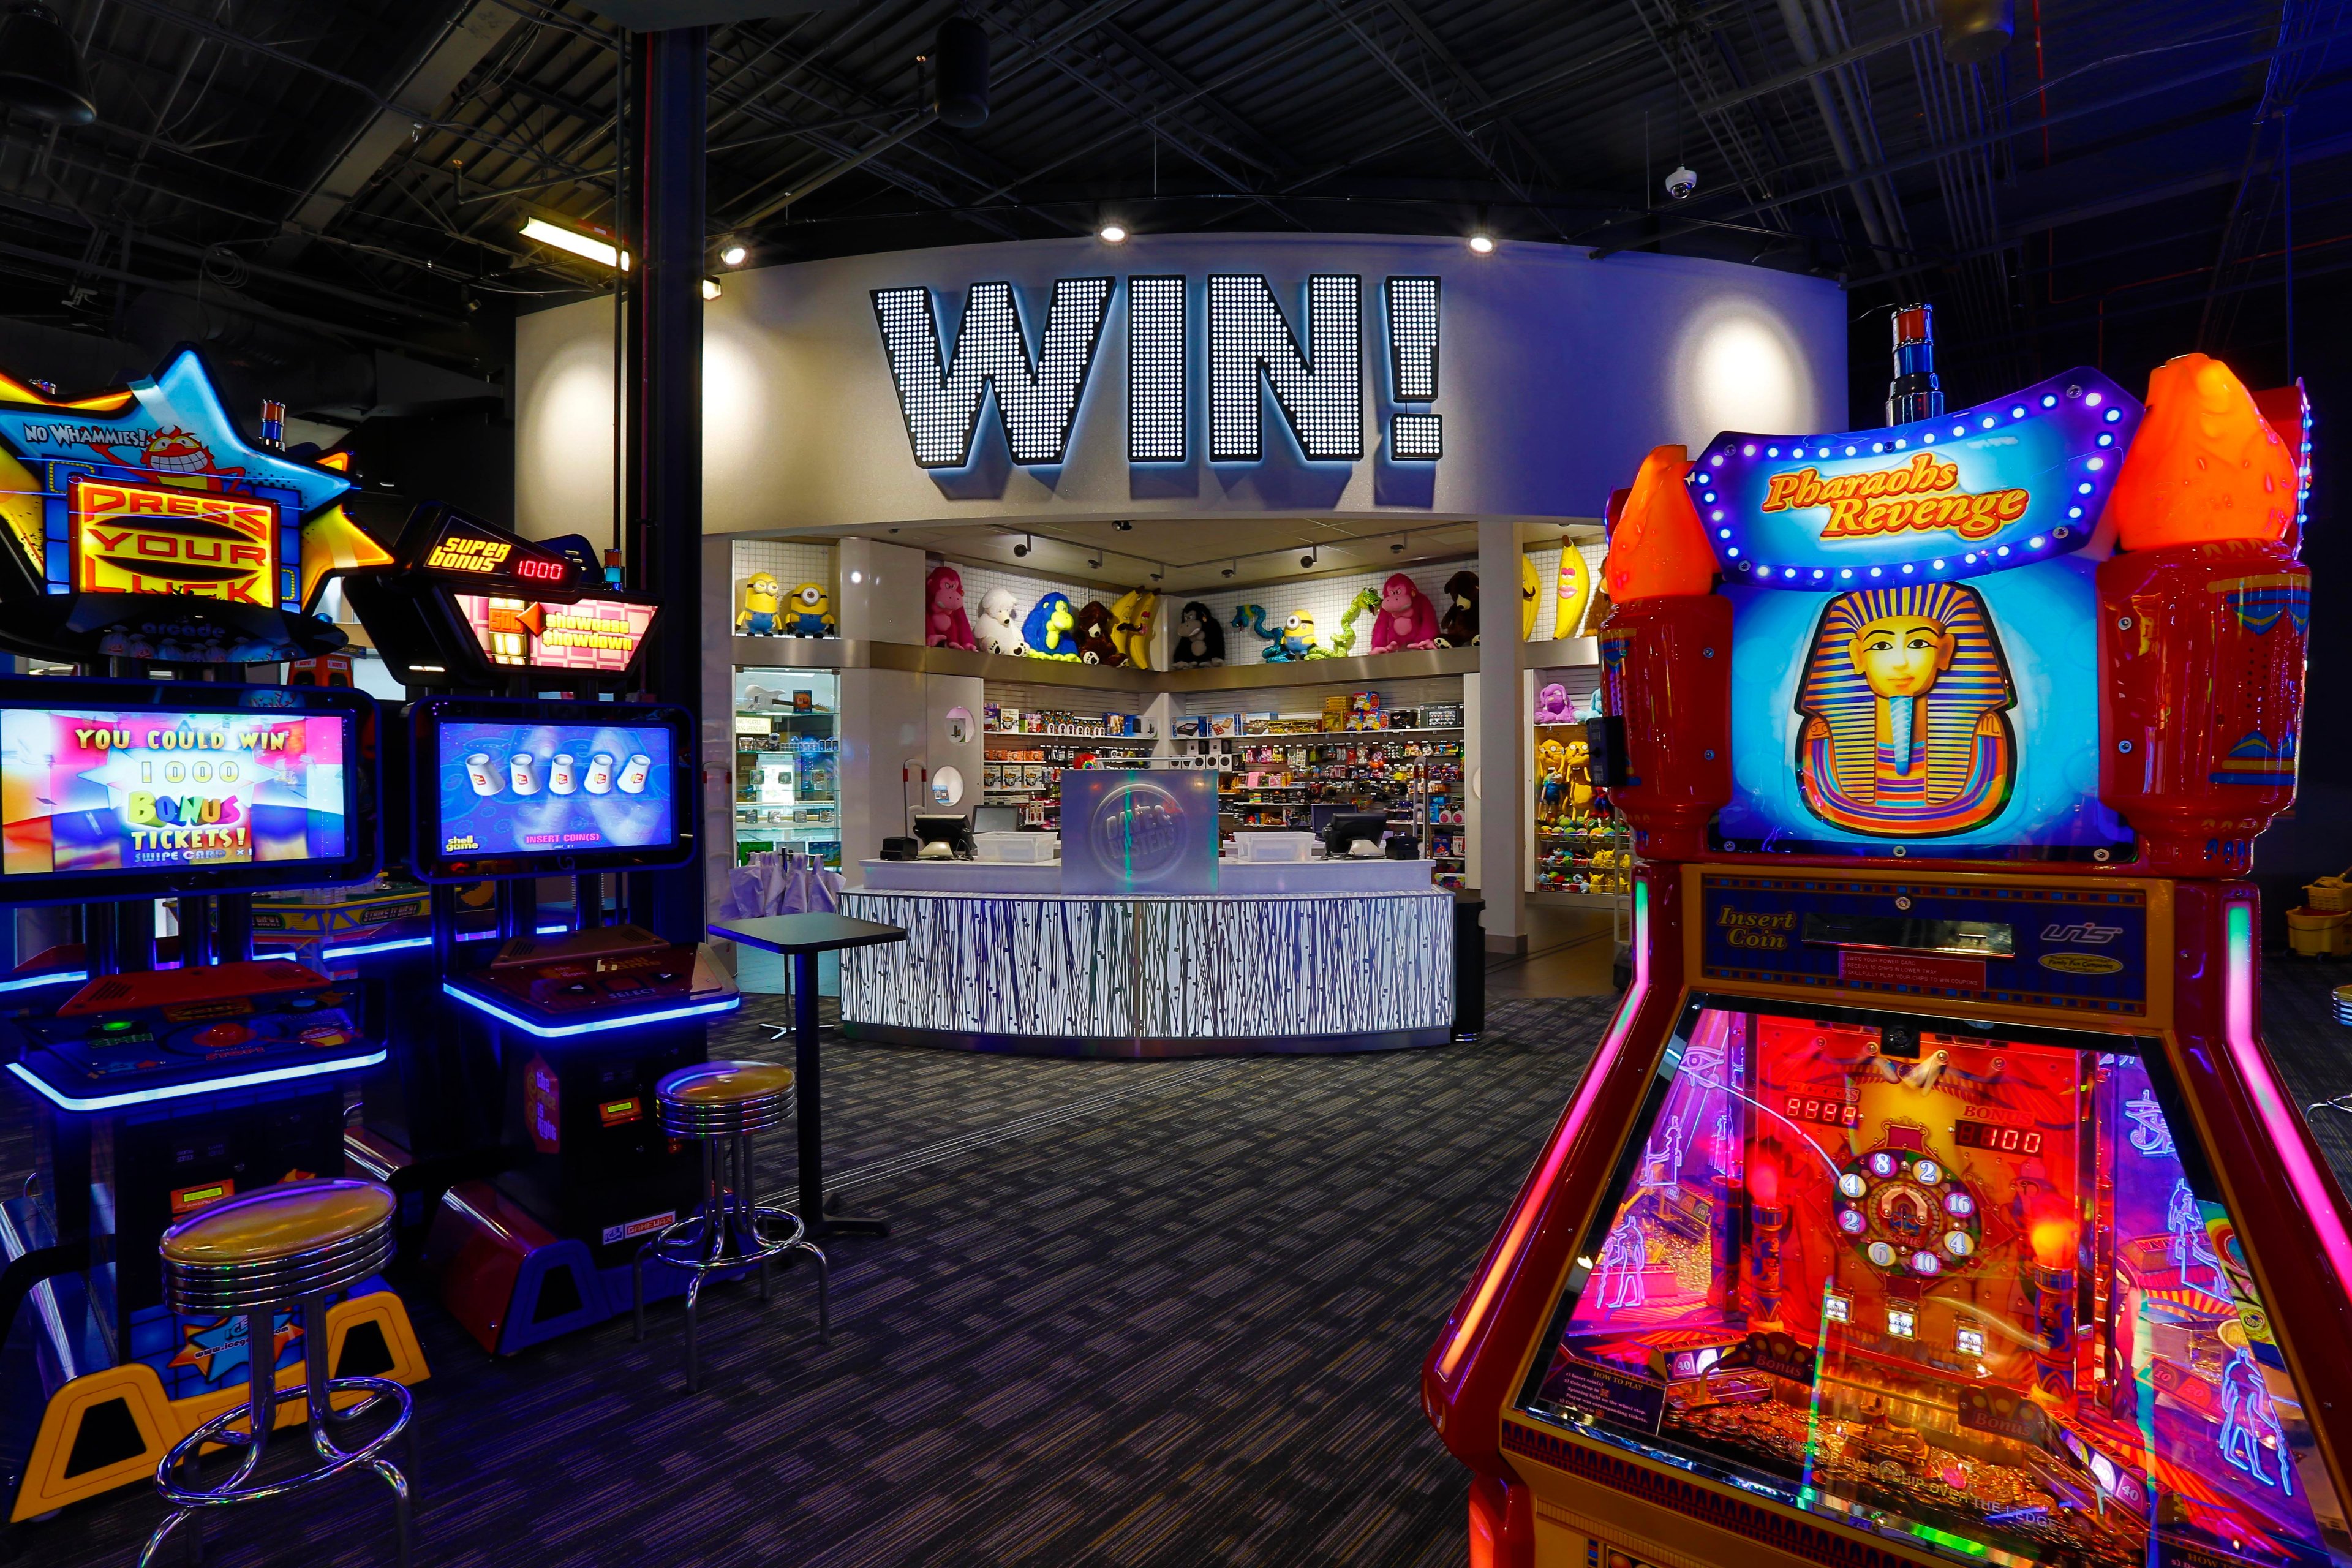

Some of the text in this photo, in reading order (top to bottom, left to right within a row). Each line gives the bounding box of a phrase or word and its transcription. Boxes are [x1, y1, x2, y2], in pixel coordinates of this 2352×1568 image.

[870, 273, 1444, 468] WIN!
[23, 422, 148, 450] NO WHAMMIES!
[1762, 451, 1958, 513] Pharaohs
[84, 486, 268, 541] PRESS
[1819, 488, 2030, 541] Revenge
[86, 528, 267, 567] YOUR
[85, 554, 263, 606] LUCK
[518, 560, 563, 579] 1000
[141, 621, 227, 638] arcade
[493, 633, 521, 655] 10
[75, 729, 285, 751] YOU COULD WIN
[141, 761, 239, 783] 1000
[127, 790, 241, 827] BONUS
[130, 827, 246, 850] TICKETS!
[445, 842, 479, 852] game
[448, 835, 474, 845] shell
[526, 833, 600, 844] INSERT COIN(S)
[134, 850, 179, 862] SWIPE
[183, 848, 226, 861] CARD
[1717, 905, 1796, 930] Insert
[1727, 927, 1787, 949] Coin
[608, 987, 657, 999] SELECT
[1786, 1080, 1861, 1102] TICKETS
[1962, 1104, 2035, 1128] BONUS
[1874, 1152, 1891, 1175] 8
[1919, 1160, 1937, 1183] 2
[1842, 1174, 1859, 1196] 4
[1697, 1207, 1705, 1216] 10
[1948, 1194, 1971, 1215] 16
[627, 1216, 673, 1234] GAMEWAX
[1842, 1210, 1860, 1232] 2
[1884, 1231, 1925, 1247] Bonus
[1949, 1231, 1966, 1255] 4
[1872, 1243, 1888, 1264] 6
[1914, 1252, 1938, 1273] 10
[1889, 1318, 1913, 1327] STOP
[1677, 1360, 1691, 1371] 40
[1755, 1354, 1803, 1378] Bonus
[2155, 1370, 2172, 1382] 10
[1572, 1373, 1586, 1381] Insert
[1581, 1382, 1594, 1392] drop
[1593, 1371, 1644, 1391] HOW TO PLAY
[1566, 1392, 1581, 1402] Player
[1592, 1401, 1627, 1417] corresponding
[1567, 1386, 1589, 1398] Spinning
[1589, 1392, 1600, 1401] light
[1618, 1401, 1634, 1411] wheel
[1973, 1411, 2033, 1438] Bonus
[1812, 1446, 1839, 1463] FOR
[1973, 1496, 2001, 1513] THE
[2005, 1505, 2058, 1530] LEDGE
[2121, 1484, 2139, 1501] 40
[2187, 1553, 2218, 1568] HOW
